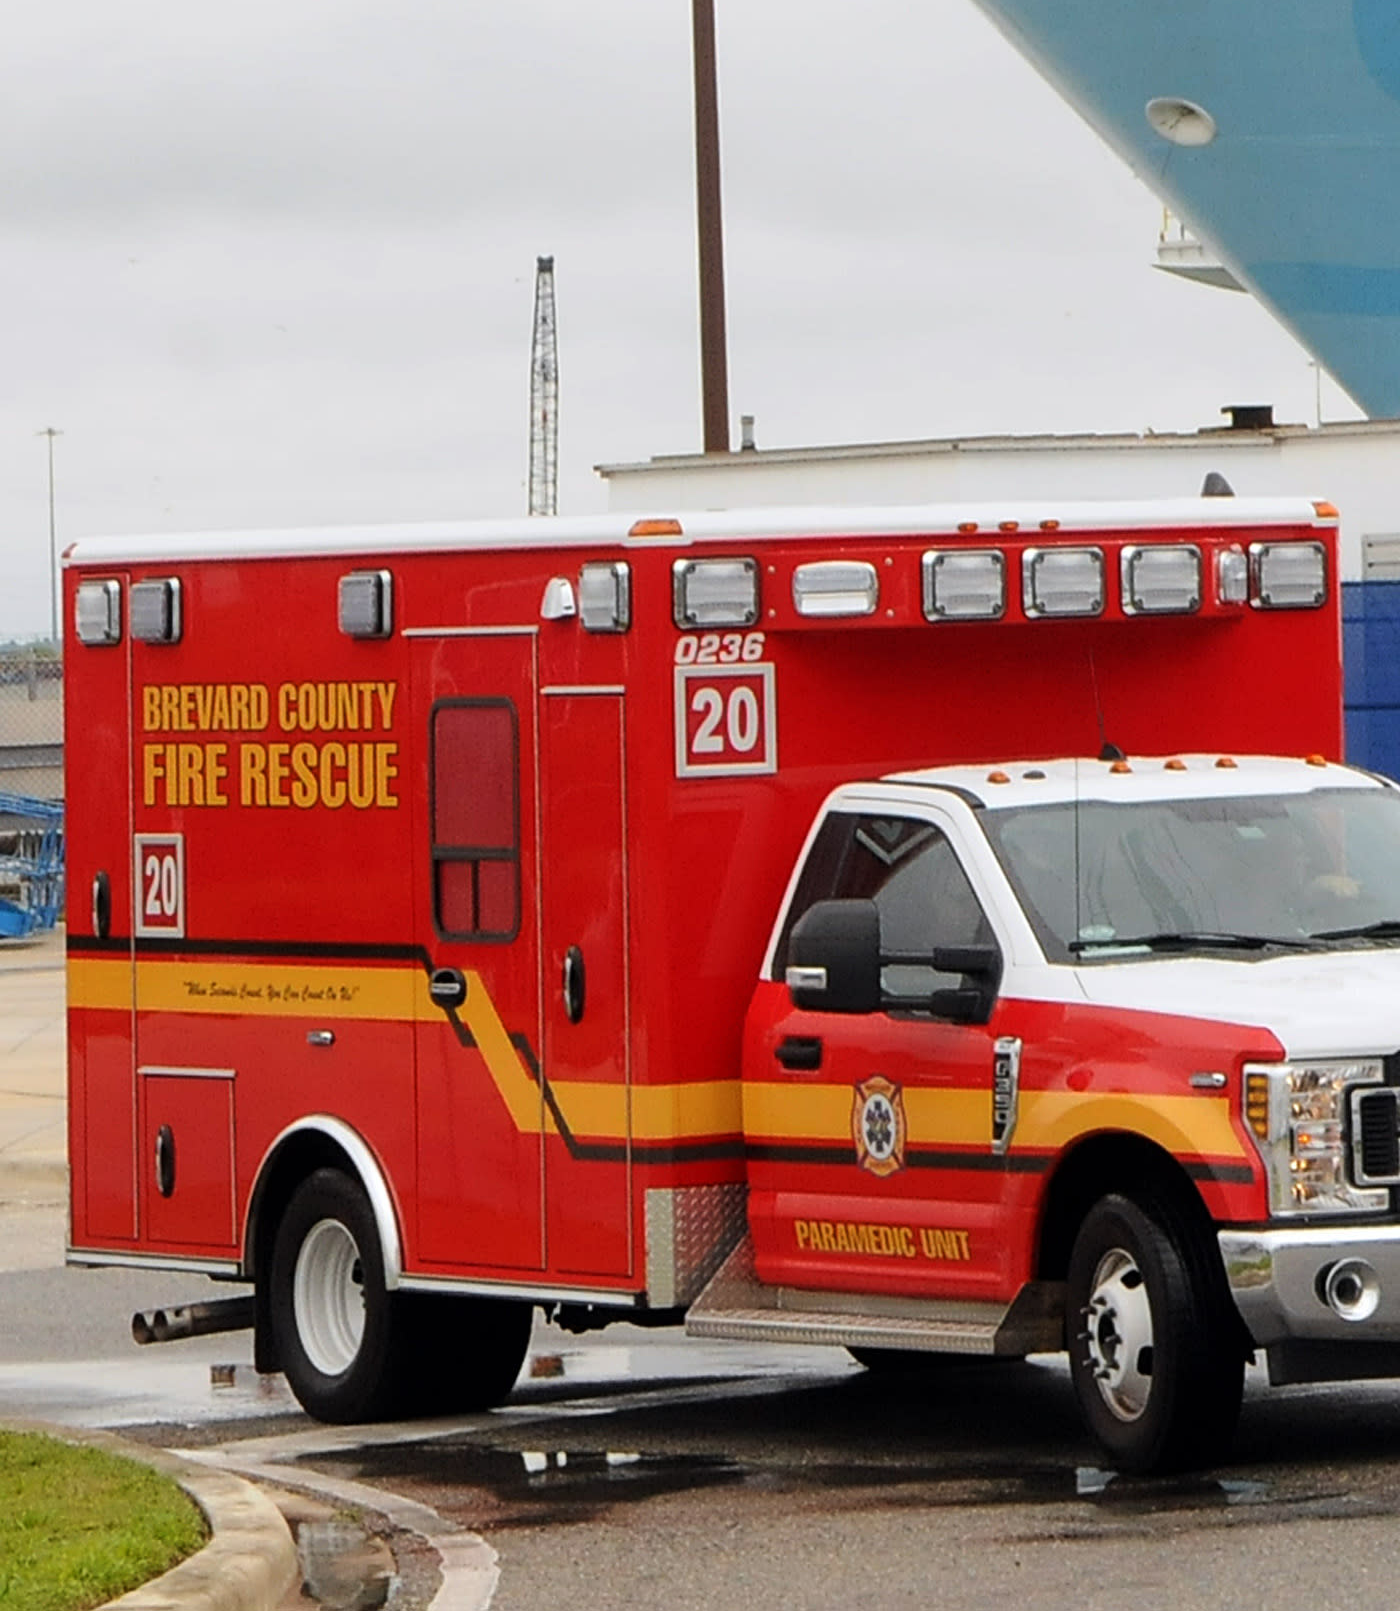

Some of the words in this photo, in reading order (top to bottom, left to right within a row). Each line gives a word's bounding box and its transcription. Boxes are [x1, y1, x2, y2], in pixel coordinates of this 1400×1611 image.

[674, 632, 766, 665] 0236
[142, 684, 269, 731] BREVARD
[278, 682, 397, 731] COUNTY
[691, 686, 760, 753] 20
[142, 742, 228, 806] FIRE
[240, 741, 399, 808] RESCUE
[145, 854, 177, 916] 20
[795, 1219, 917, 1258] PARAMEDIC
[919, 1228, 971, 1261] UNIT
